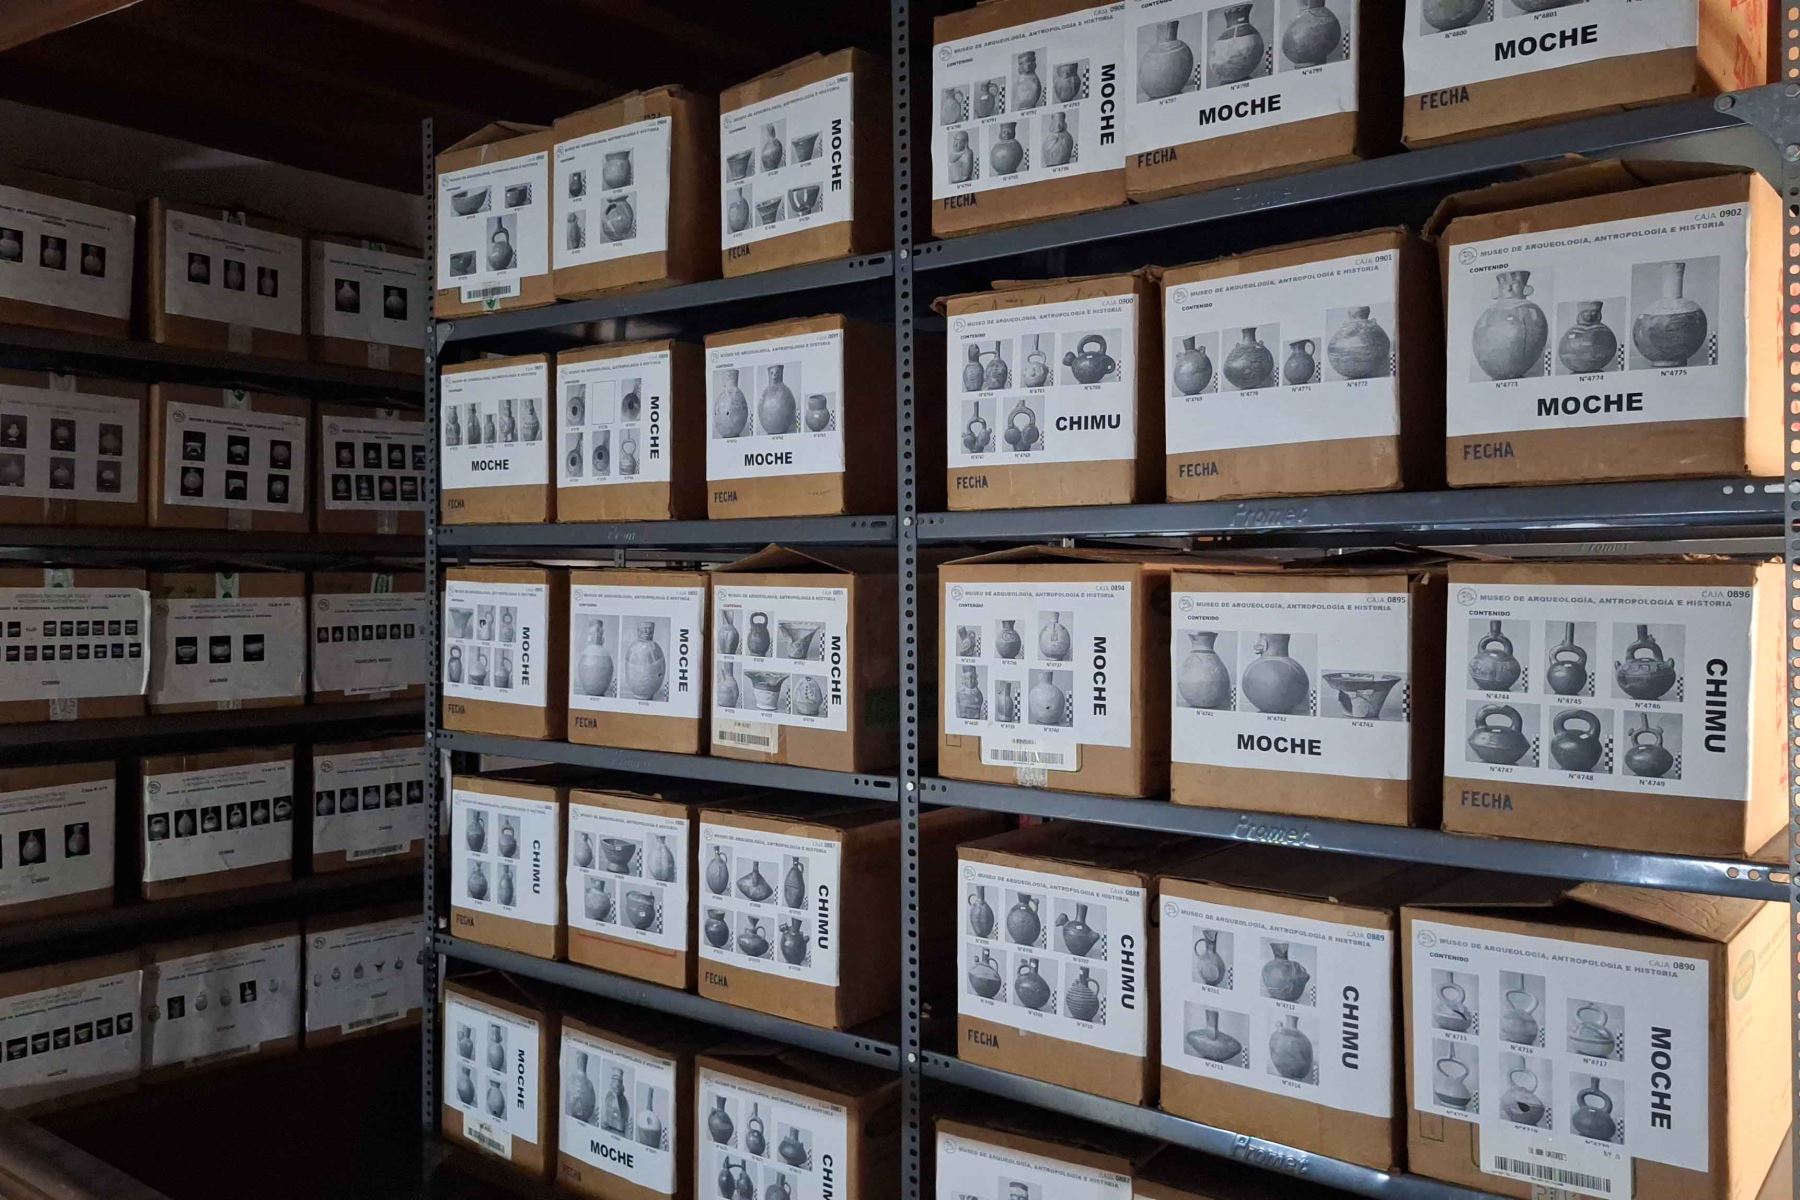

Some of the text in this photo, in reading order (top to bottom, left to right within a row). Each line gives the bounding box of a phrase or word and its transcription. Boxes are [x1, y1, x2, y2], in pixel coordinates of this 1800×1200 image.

[1494, 24, 1598, 61] MOCHE
[1100, 64, 1115, 146] MOCHE
[1420, 86, 1470, 111] FECHA
[1200, 94, 1281, 126] MOCHE
[832, 119, 841, 192] MOCHE
[1138, 148, 1177, 168] FECHA
[944, 193, 977, 210] FECHA
[1720, 208, 1742, 218] 0902
[1480, 248, 1508, 256] MUSEO
[1679, 220, 1724, 232] HISTORIA
[1374, 254, 1392, 263] 0901
[1469, 263, 1508, 273] CONTENIDO
[1190, 288, 1213, 297] MUSEO
[1344, 265, 1379, 274] HISTORIA
[1182, 302, 1213, 311] CONTENIDO
[1660, 369, 1687, 378] N°4775
[1536, 392, 1644, 416] MOCHE
[650, 396, 660, 459] MOCHE
[1056, 414, 1121, 432] CHIMU
[744, 452, 792, 466] MOCHE
[1464, 442, 1514, 460] FECHA
[472, 459, 509, 472] MOCHE
[1179, 462, 1218, 478] FECHA
[956, 475, 988, 489] FECHA
[714, 491, 738, 503] FECHA
[1727, 590, 1750, 598] 0896
[522, 627, 530, 686] MOCHE
[678, 629, 688, 692] MOCHE
[831, 636, 841, 705] MOCHE
[1093, 636, 1106, 716] MOCHE
[1704, 658, 1728, 753] CHIMU
[575, 716, 598, 728] FECHA
[1237, 734, 1322, 756] MOCHE
[1461, 790, 1512, 810] FECHA
[532, 840, 540, 894] CHIMU
[818, 884, 828, 950] CHIMU
[1367, 932, 1384, 942] 0889
[1429, 952, 1468, 962] CONTENIDO
[1439, 938, 1468, 948] MUSEO
[1634, 966, 1678, 978] HISTORIA
[1673, 962, 1696, 972] 0890
[705, 972, 728, 987] FECHA
[1121, 934, 1134, 1010] CHIMU
[1342, 985, 1360, 1070] CHIMU
[968, 1030, 999, 1048] FECHA
[517, 1050, 525, 1110] MOCHE
[1650, 1026, 1672, 1130] MOCHE
[591, 1140, 634, 1168] MOCHE
